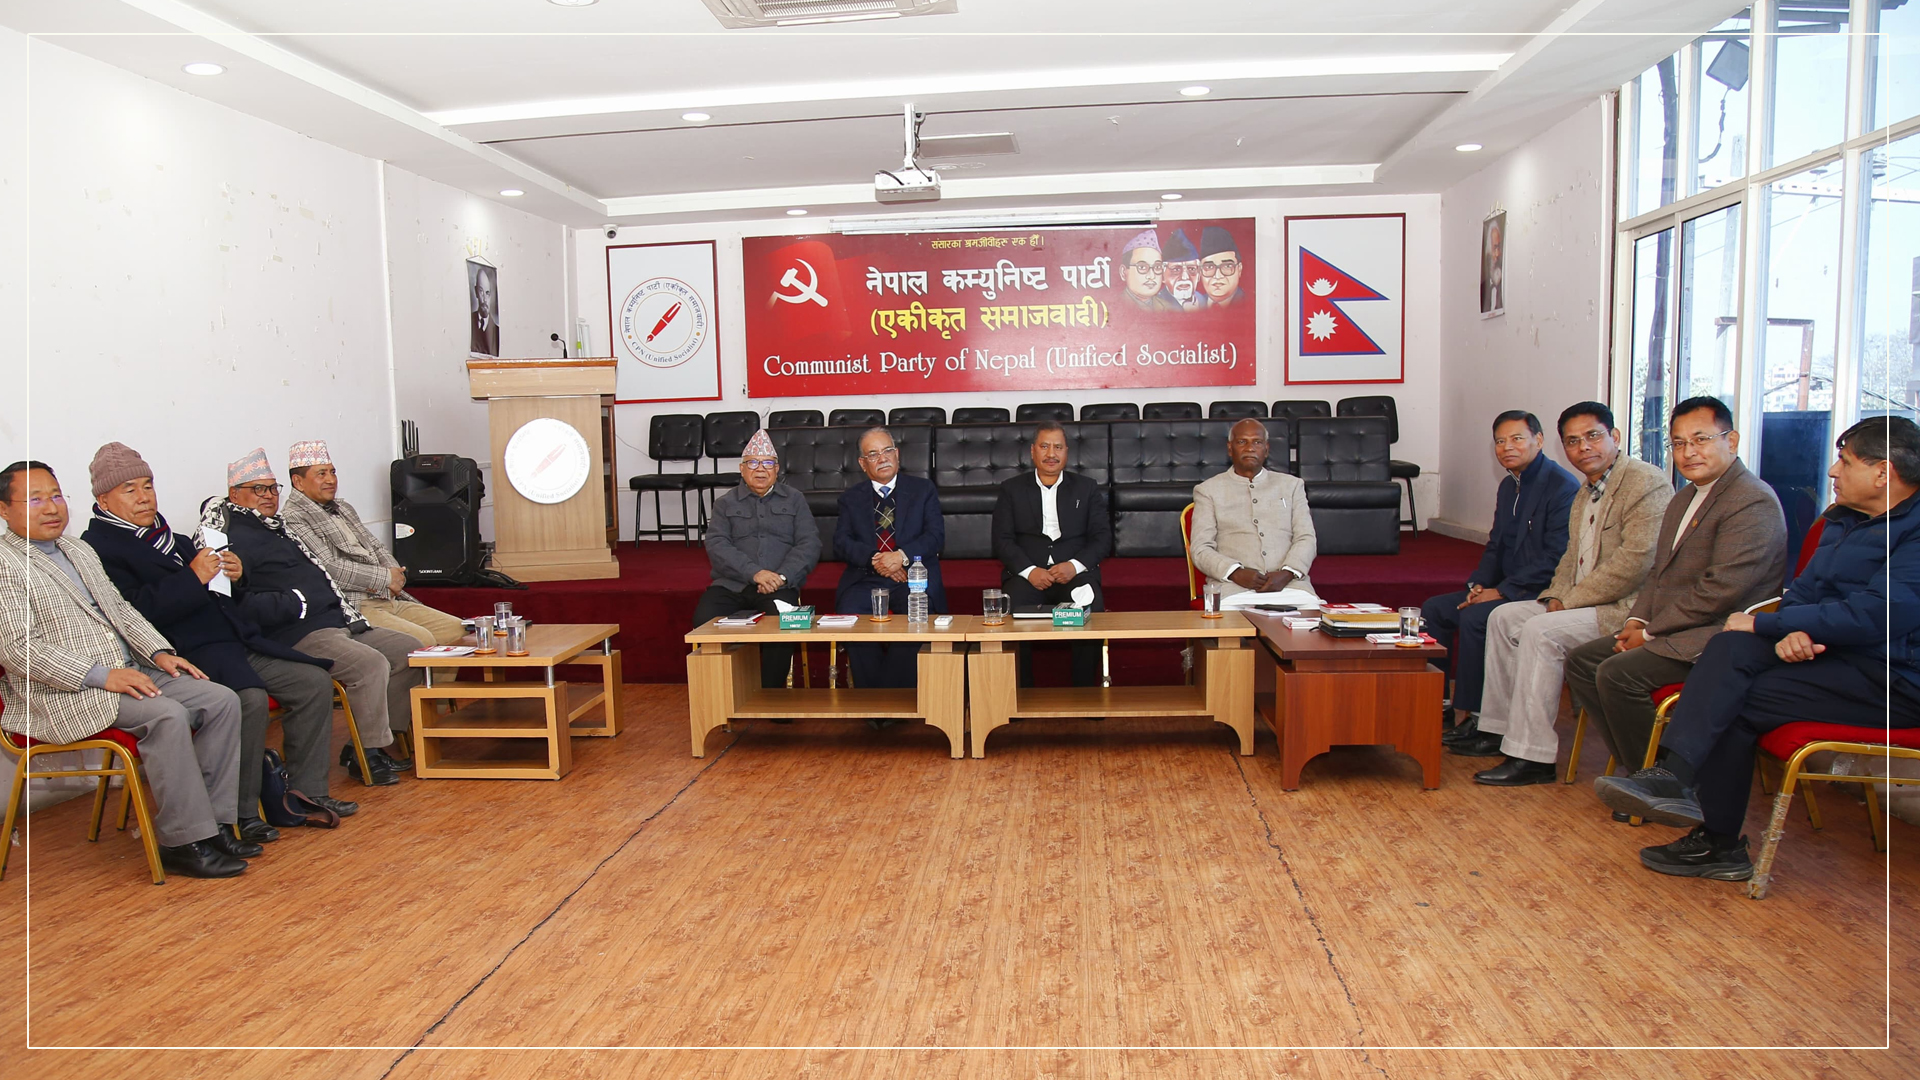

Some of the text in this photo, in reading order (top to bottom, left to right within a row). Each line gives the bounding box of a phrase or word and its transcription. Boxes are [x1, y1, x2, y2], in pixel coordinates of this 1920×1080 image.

[865, 256, 1112, 300] नेपाल कम्युनिष्ट पार्टी
[870, 295, 1109, 339] (एकीकृत समाजवादी)
[631, 337, 699, 363] CPN (Unified Socialist)
[763, 341, 1237, 379] Communist Party of Nepal (Unified Socialist)
[781, 614, 808, 622] PREMIUM
